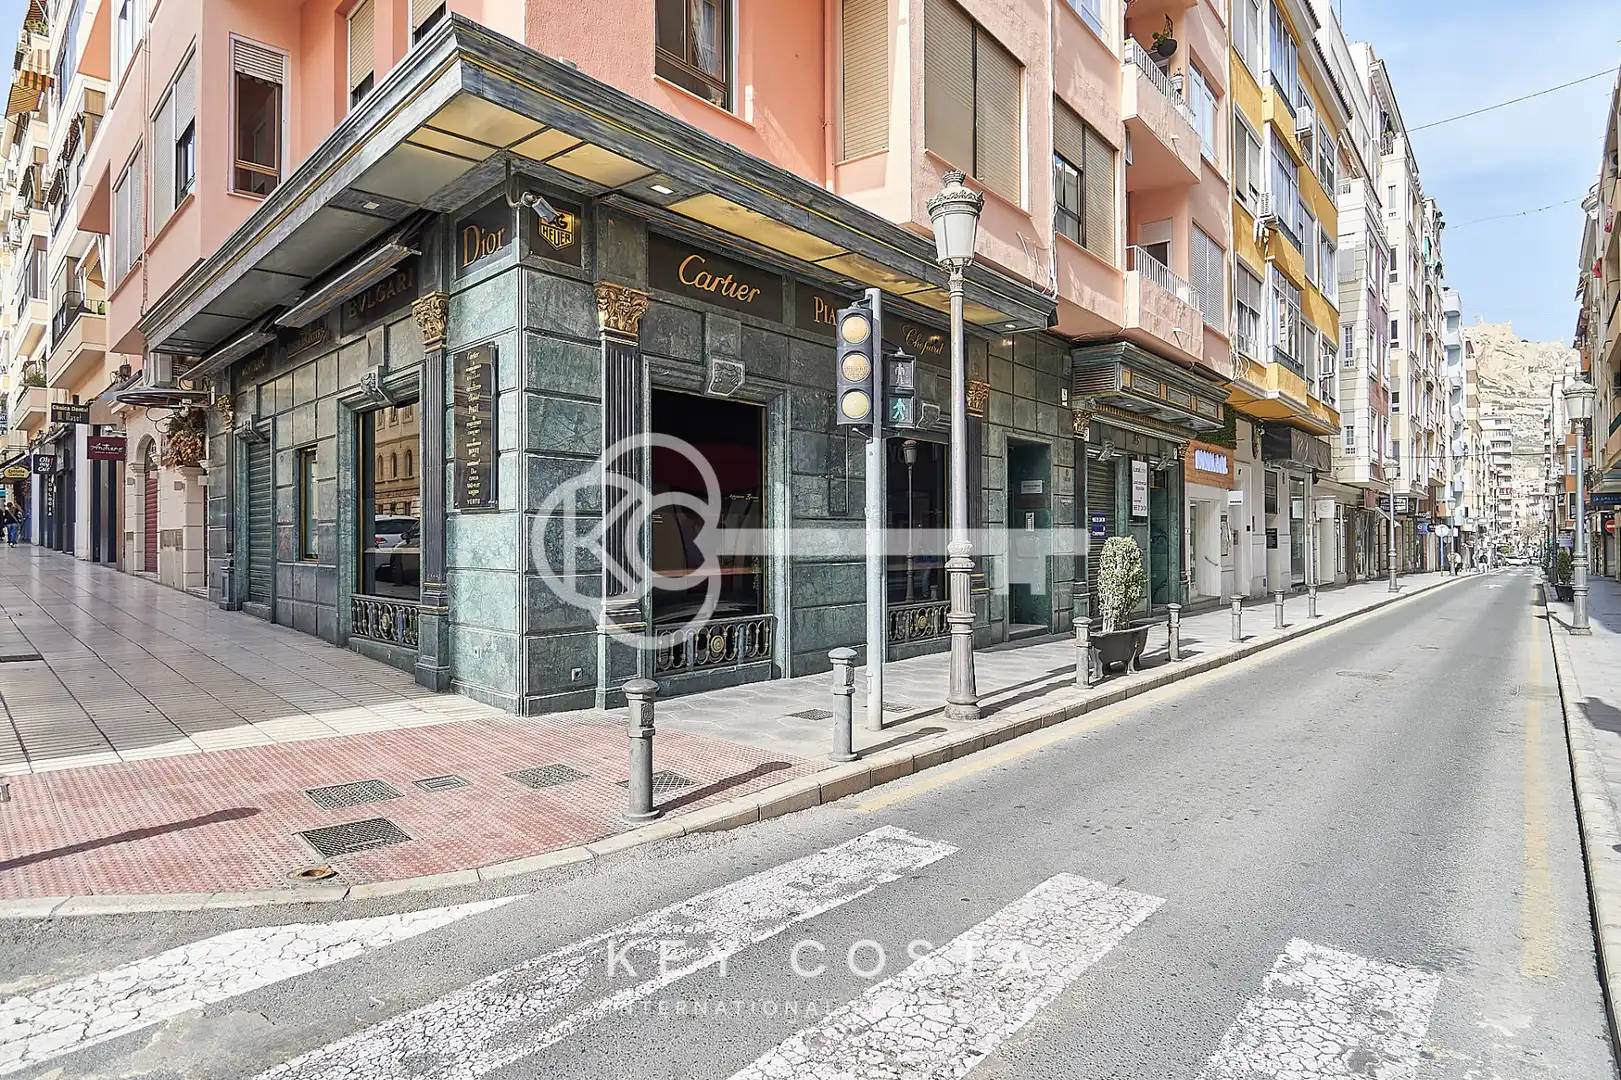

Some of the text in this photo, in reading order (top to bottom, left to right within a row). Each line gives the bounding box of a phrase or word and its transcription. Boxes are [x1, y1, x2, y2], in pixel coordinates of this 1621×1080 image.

[462, 225, 505, 268] Dior
[541, 225, 572, 246] HEUER
[678, 254, 761, 304] Cartier
[902, 323, 945, 356] Chopard
